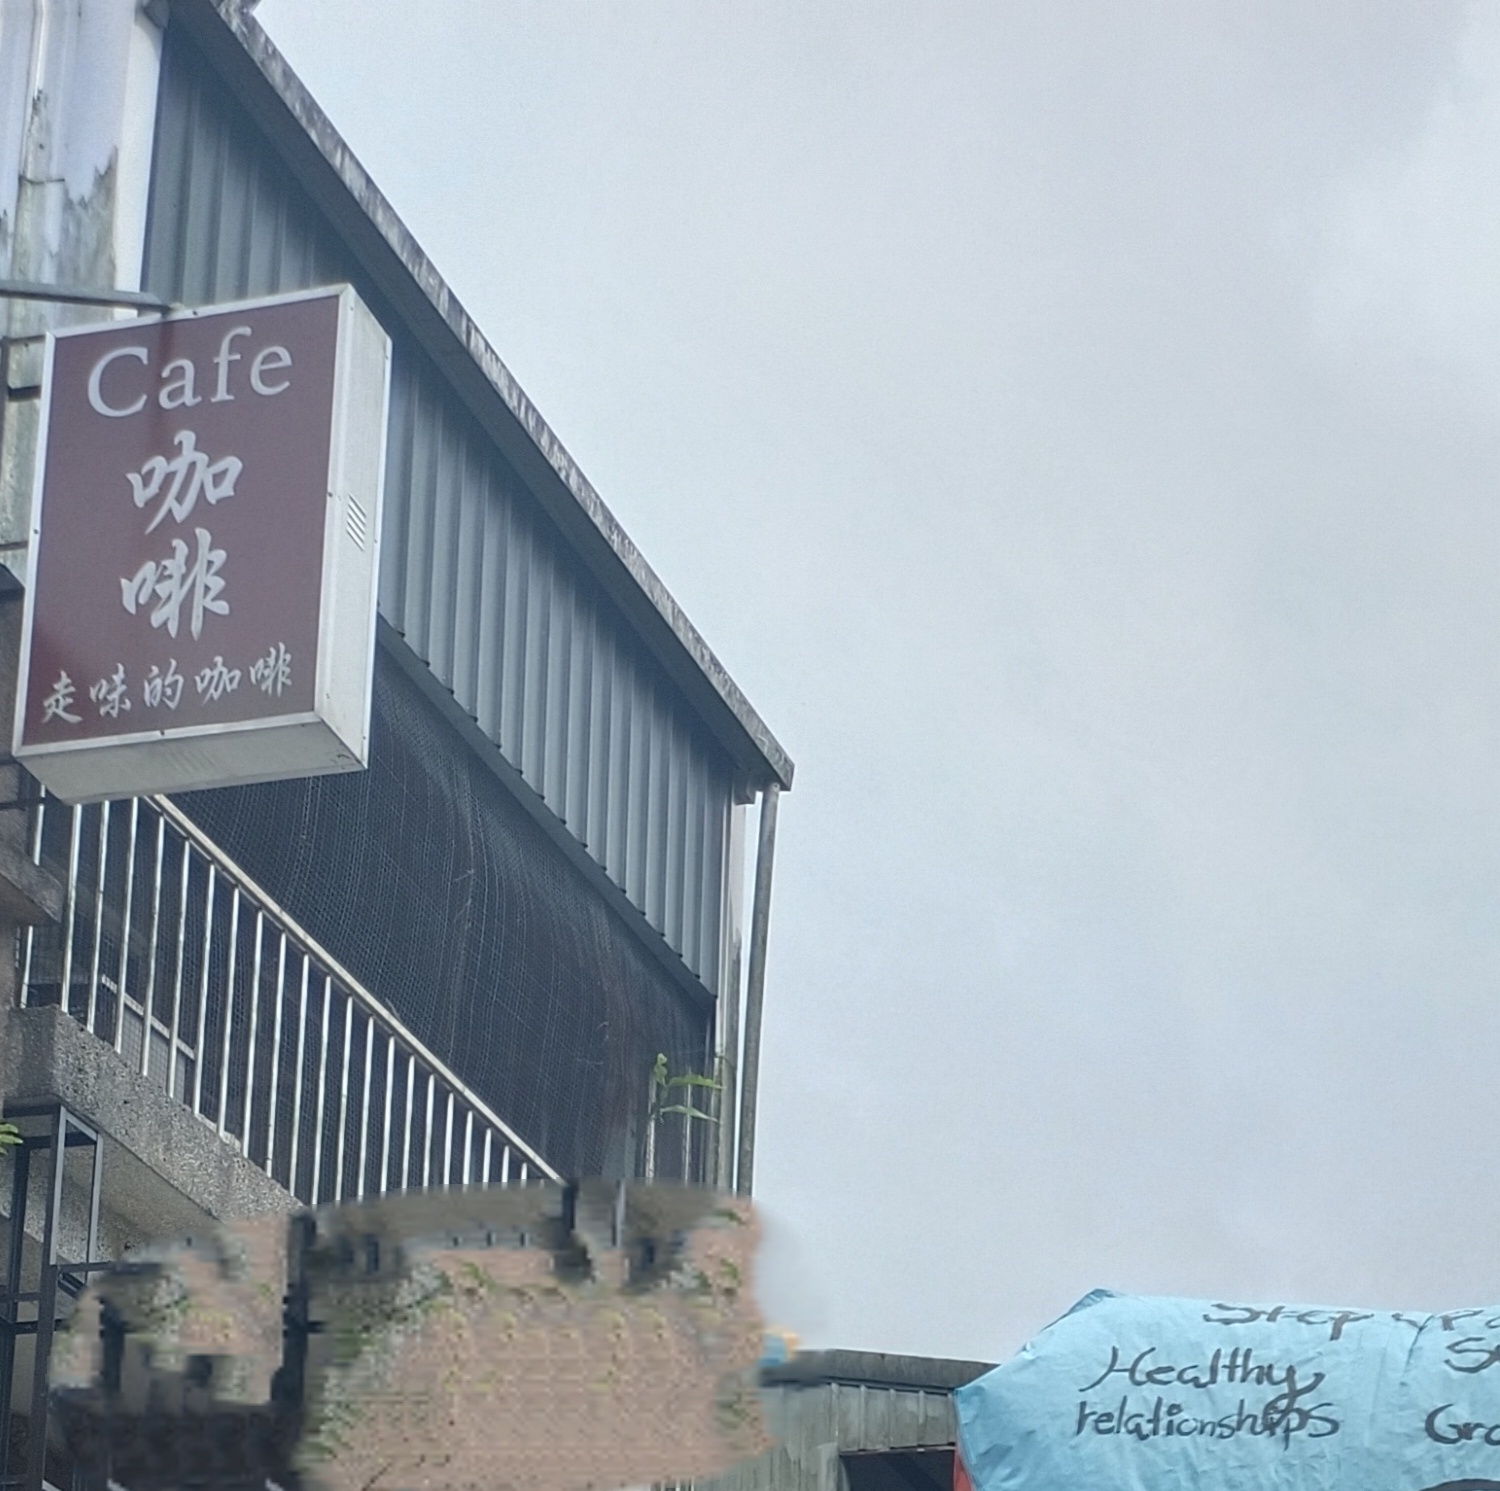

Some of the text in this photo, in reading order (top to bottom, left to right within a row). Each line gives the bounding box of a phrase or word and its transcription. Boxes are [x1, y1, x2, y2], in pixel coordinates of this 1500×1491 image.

[87, 326, 292, 417] Cafe
[120, 430, 243, 640] 咖啡
[41, 642, 293, 724] 走味的咖啡
[1078, 1345, 1327, 1416] Healthy
[1076, 1395, 1340, 1451] relationships
